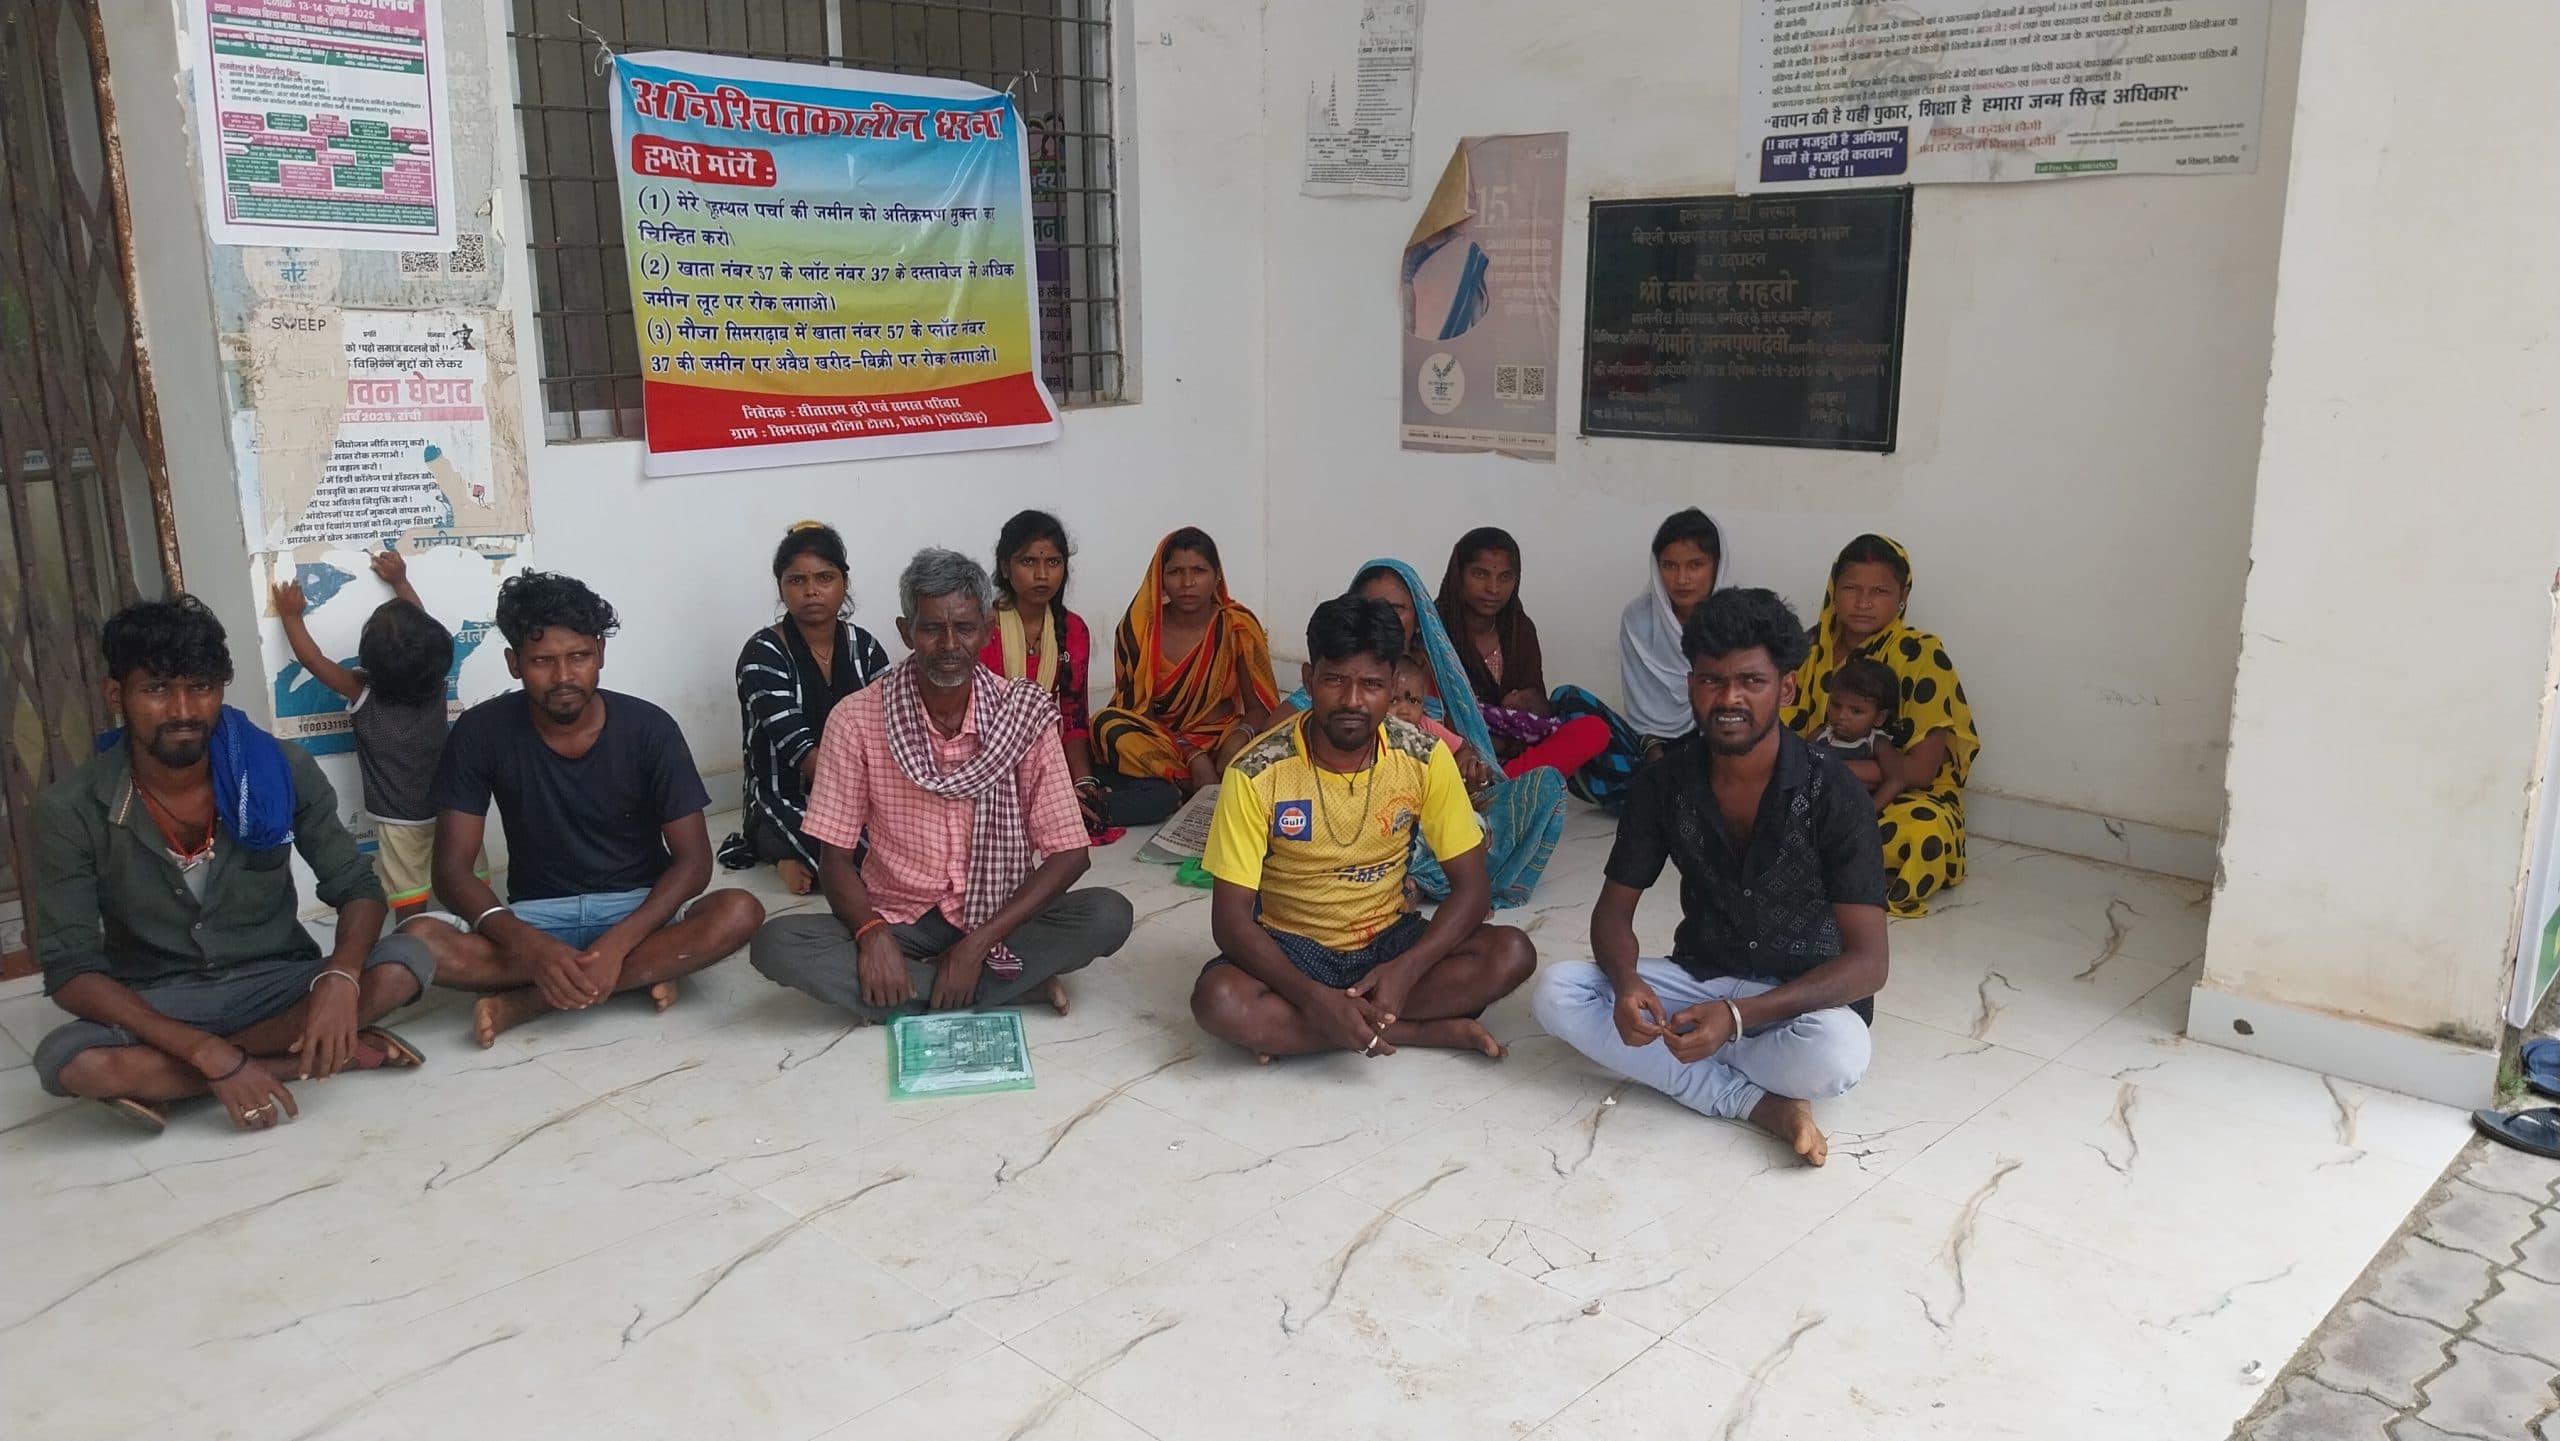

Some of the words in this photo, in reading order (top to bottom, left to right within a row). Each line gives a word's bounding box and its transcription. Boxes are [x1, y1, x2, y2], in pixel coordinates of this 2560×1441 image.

[352, 8, 375, 19] 2025
[1812, 108, 1828, 125] की
[1832, 105, 1842, 124] है
[1846, 104, 1871, 123] यही
[1873, 104, 1912, 125] पुकार,
[1919, 98, 1957, 117] शिक्षा
[1961, 95, 1972, 115] है
[1983, 96, 2024, 112] हमारा
[2028, 92, 2065, 109] जन्म
[933, 107, 1005, 142] धरना
[1777, 138, 1799, 150] बाल
[1801, 133, 1838, 150] मजदूरी
[1840, 131, 1849, 145] है
[1852, 130, 1904, 145] अभिशाप,
[642, 146, 701, 175] हमारी
[1800, 150, 1811, 164] से
[1812, 149, 1850, 167] मजदूरी
[1851, 147, 1894, 161] करवाना
[1808, 165, 1817, 180] है
[1819, 166, 1840, 179] पाप
[638, 186, 670, 216] (1)
[677, 190, 699, 213] मेरे
[754, 198, 784, 219] पर्चा
[791, 200, 809, 220] की
[814, 201, 853, 223] जमीन
[859, 203, 877, 222] को
[882, 203, 946, 224] अतिक्रमण
[951, 206, 978, 227] मुक्त
[640, 252, 670, 281] (2)
[677, 261, 715, 278] खाता
[721, 259, 754, 280] नंबर
[780, 260, 794, 281] के
[798, 261, 829, 281] प्लॉट
[835, 263, 866, 281] नंबर
[871, 268, 890, 281] 37
[895, 262, 907, 281] के
[911, 262, 962, 281] दस्तावेज
[968, 260, 977, 278] से
[981, 258, 1015, 278] अधिक
[643, 286, 690, 309] जमीन
[696, 294, 720, 316] लूट
[724, 295, 744, 310] पर
[748, 290, 777, 311] रोक
[782, 292, 836, 311] लगाओ।
[647, 317, 673, 346] (3)
[677, 316, 720, 341] मौजा
[794, 321, 808, 341] में
[812, 325, 847, 341] खाता
[852, 321, 882, 340] नंबर
[887, 325, 905, 340] 57
[910, 319, 923, 338] के
[927, 318, 958, 338] प्लॉट
[961, 318, 986, 335] नंबर
[376, 344, 400, 353] समाज
[403, 342, 428, 353] बदलने
[429, 342, 440, 353] को
[651, 356, 670, 372] 37
[676, 351, 695, 372] की
[700, 351, 745, 372] जमीन
[751, 357, 772, 372] पर
[776, 348, 809, 371] अवैध
[898, 353, 917, 367] पर
[921, 347, 947, 367] रोक
[950, 345, 997, 364] लगाओ।
[353, 357, 394, 369] विभिन्न
[420, 358, 433, 369] को
[436, 357, 463, 369] लेकर
[405, 371, 474, 405] घेराव
[741, 405, 786, 420] निवेदक
[798, 403, 847, 417] सीताराम
[849, 403, 871, 418] तुरी
[872, 400, 888, 414] एवं
[891, 400, 923, 413] समस्त
[924, 397, 961, 410] परिवार
[730, 427, 758, 440] ग्राम
[1281, 817, 1304, 826] Gulf
